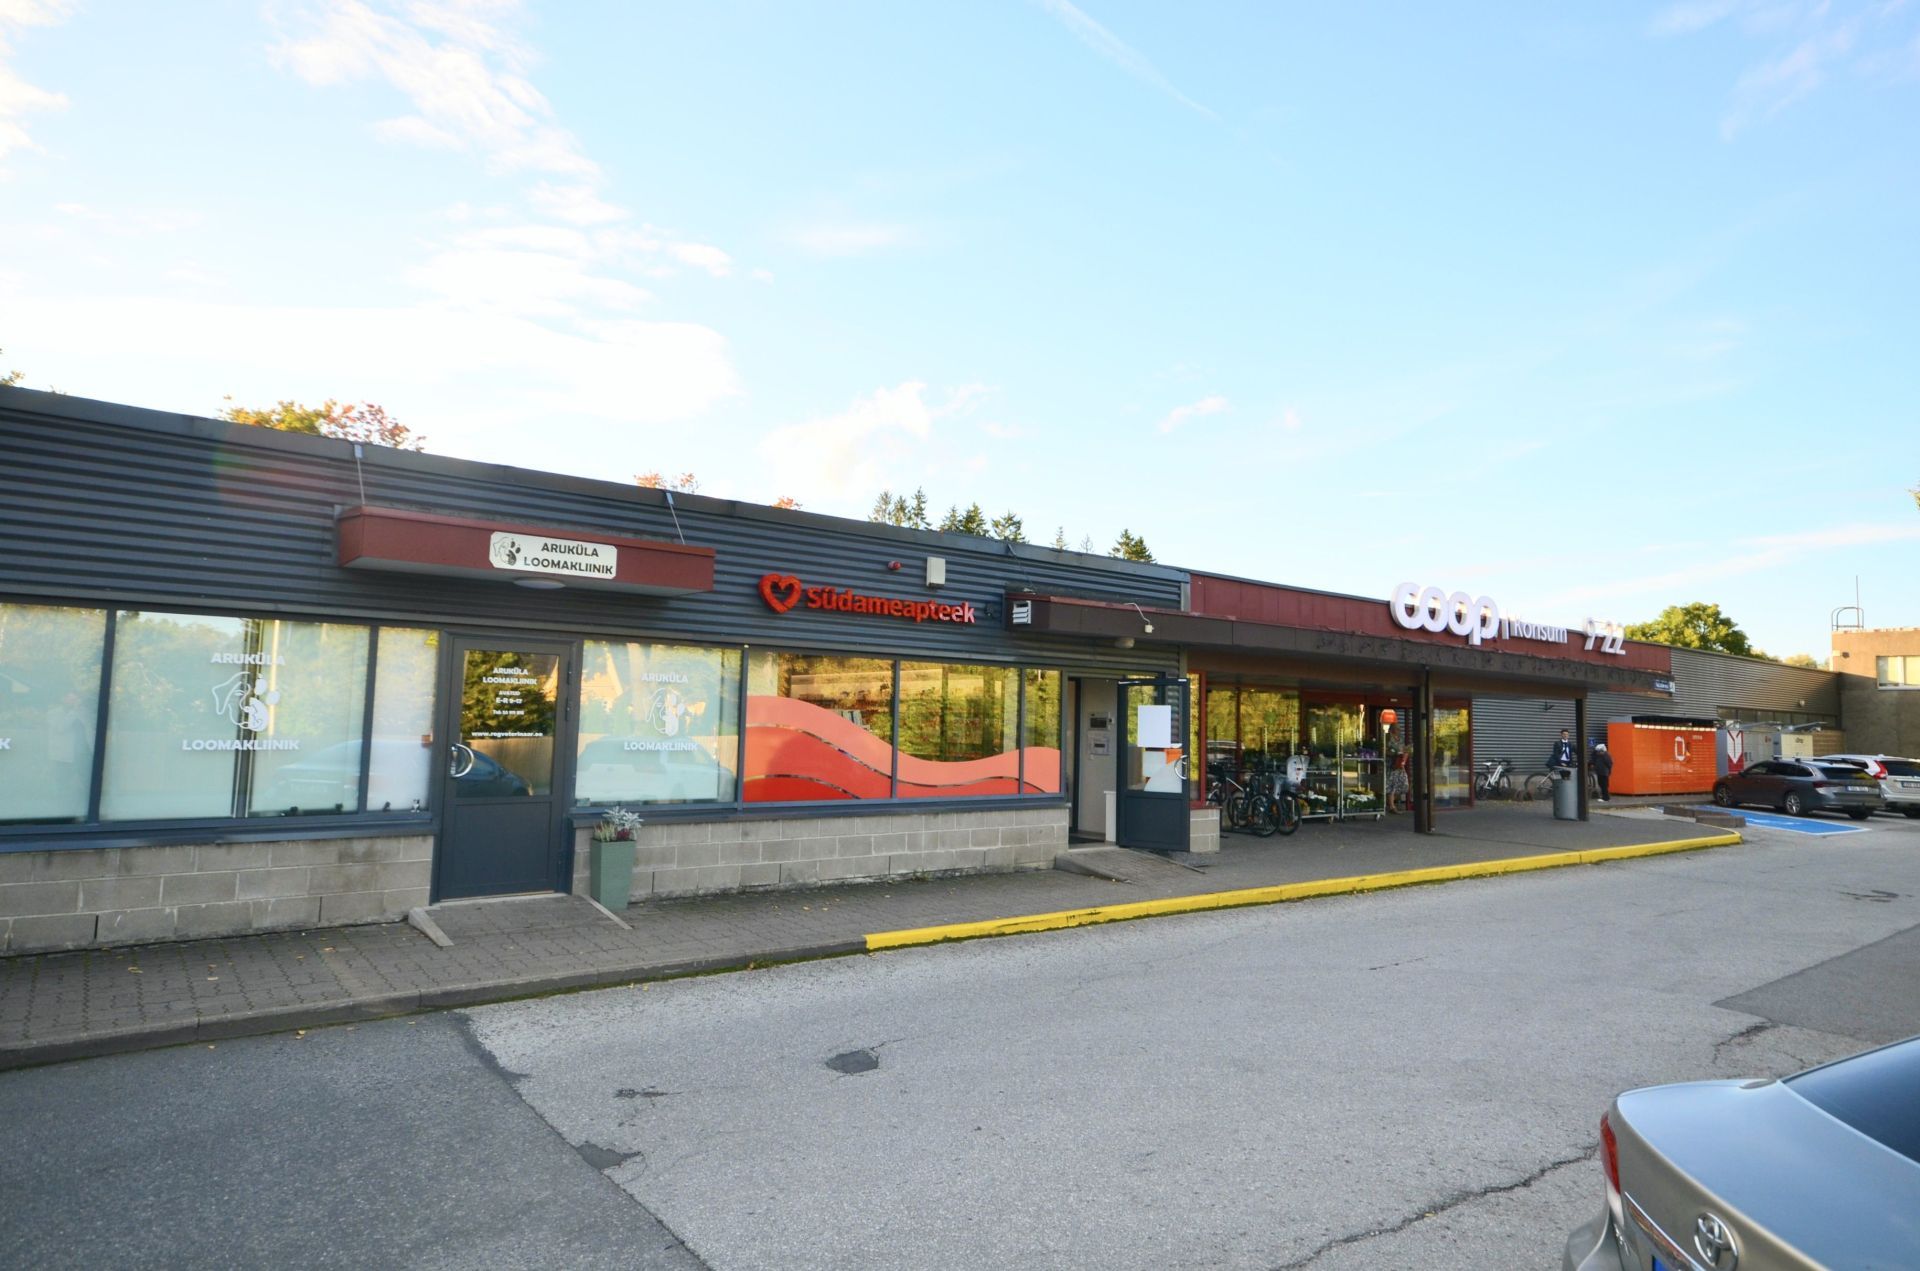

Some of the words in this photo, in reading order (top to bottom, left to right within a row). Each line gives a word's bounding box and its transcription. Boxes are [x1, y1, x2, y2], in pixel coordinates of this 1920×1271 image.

[541, 541, 599, 558] ARUKÜLA
[523, 556, 613, 575] LOOMAKLIINIK
[807, 587, 975, 624] Südameapteek
[1390, 582, 1499, 646] coop
[1511, 615, 1568, 644] Konsum
[210, 652, 286, 666] ARUKÜLA
[492, 667, 529, 676] ARUKÜLA
[641, 672, 689, 684] ARUKÜLA
[482, 676, 537, 686] LOOMAKLIINIK
[182, 739, 300, 751] LOOMAKLIINIK
[623, 741, 699, 752] LOOMAKLIINIK
